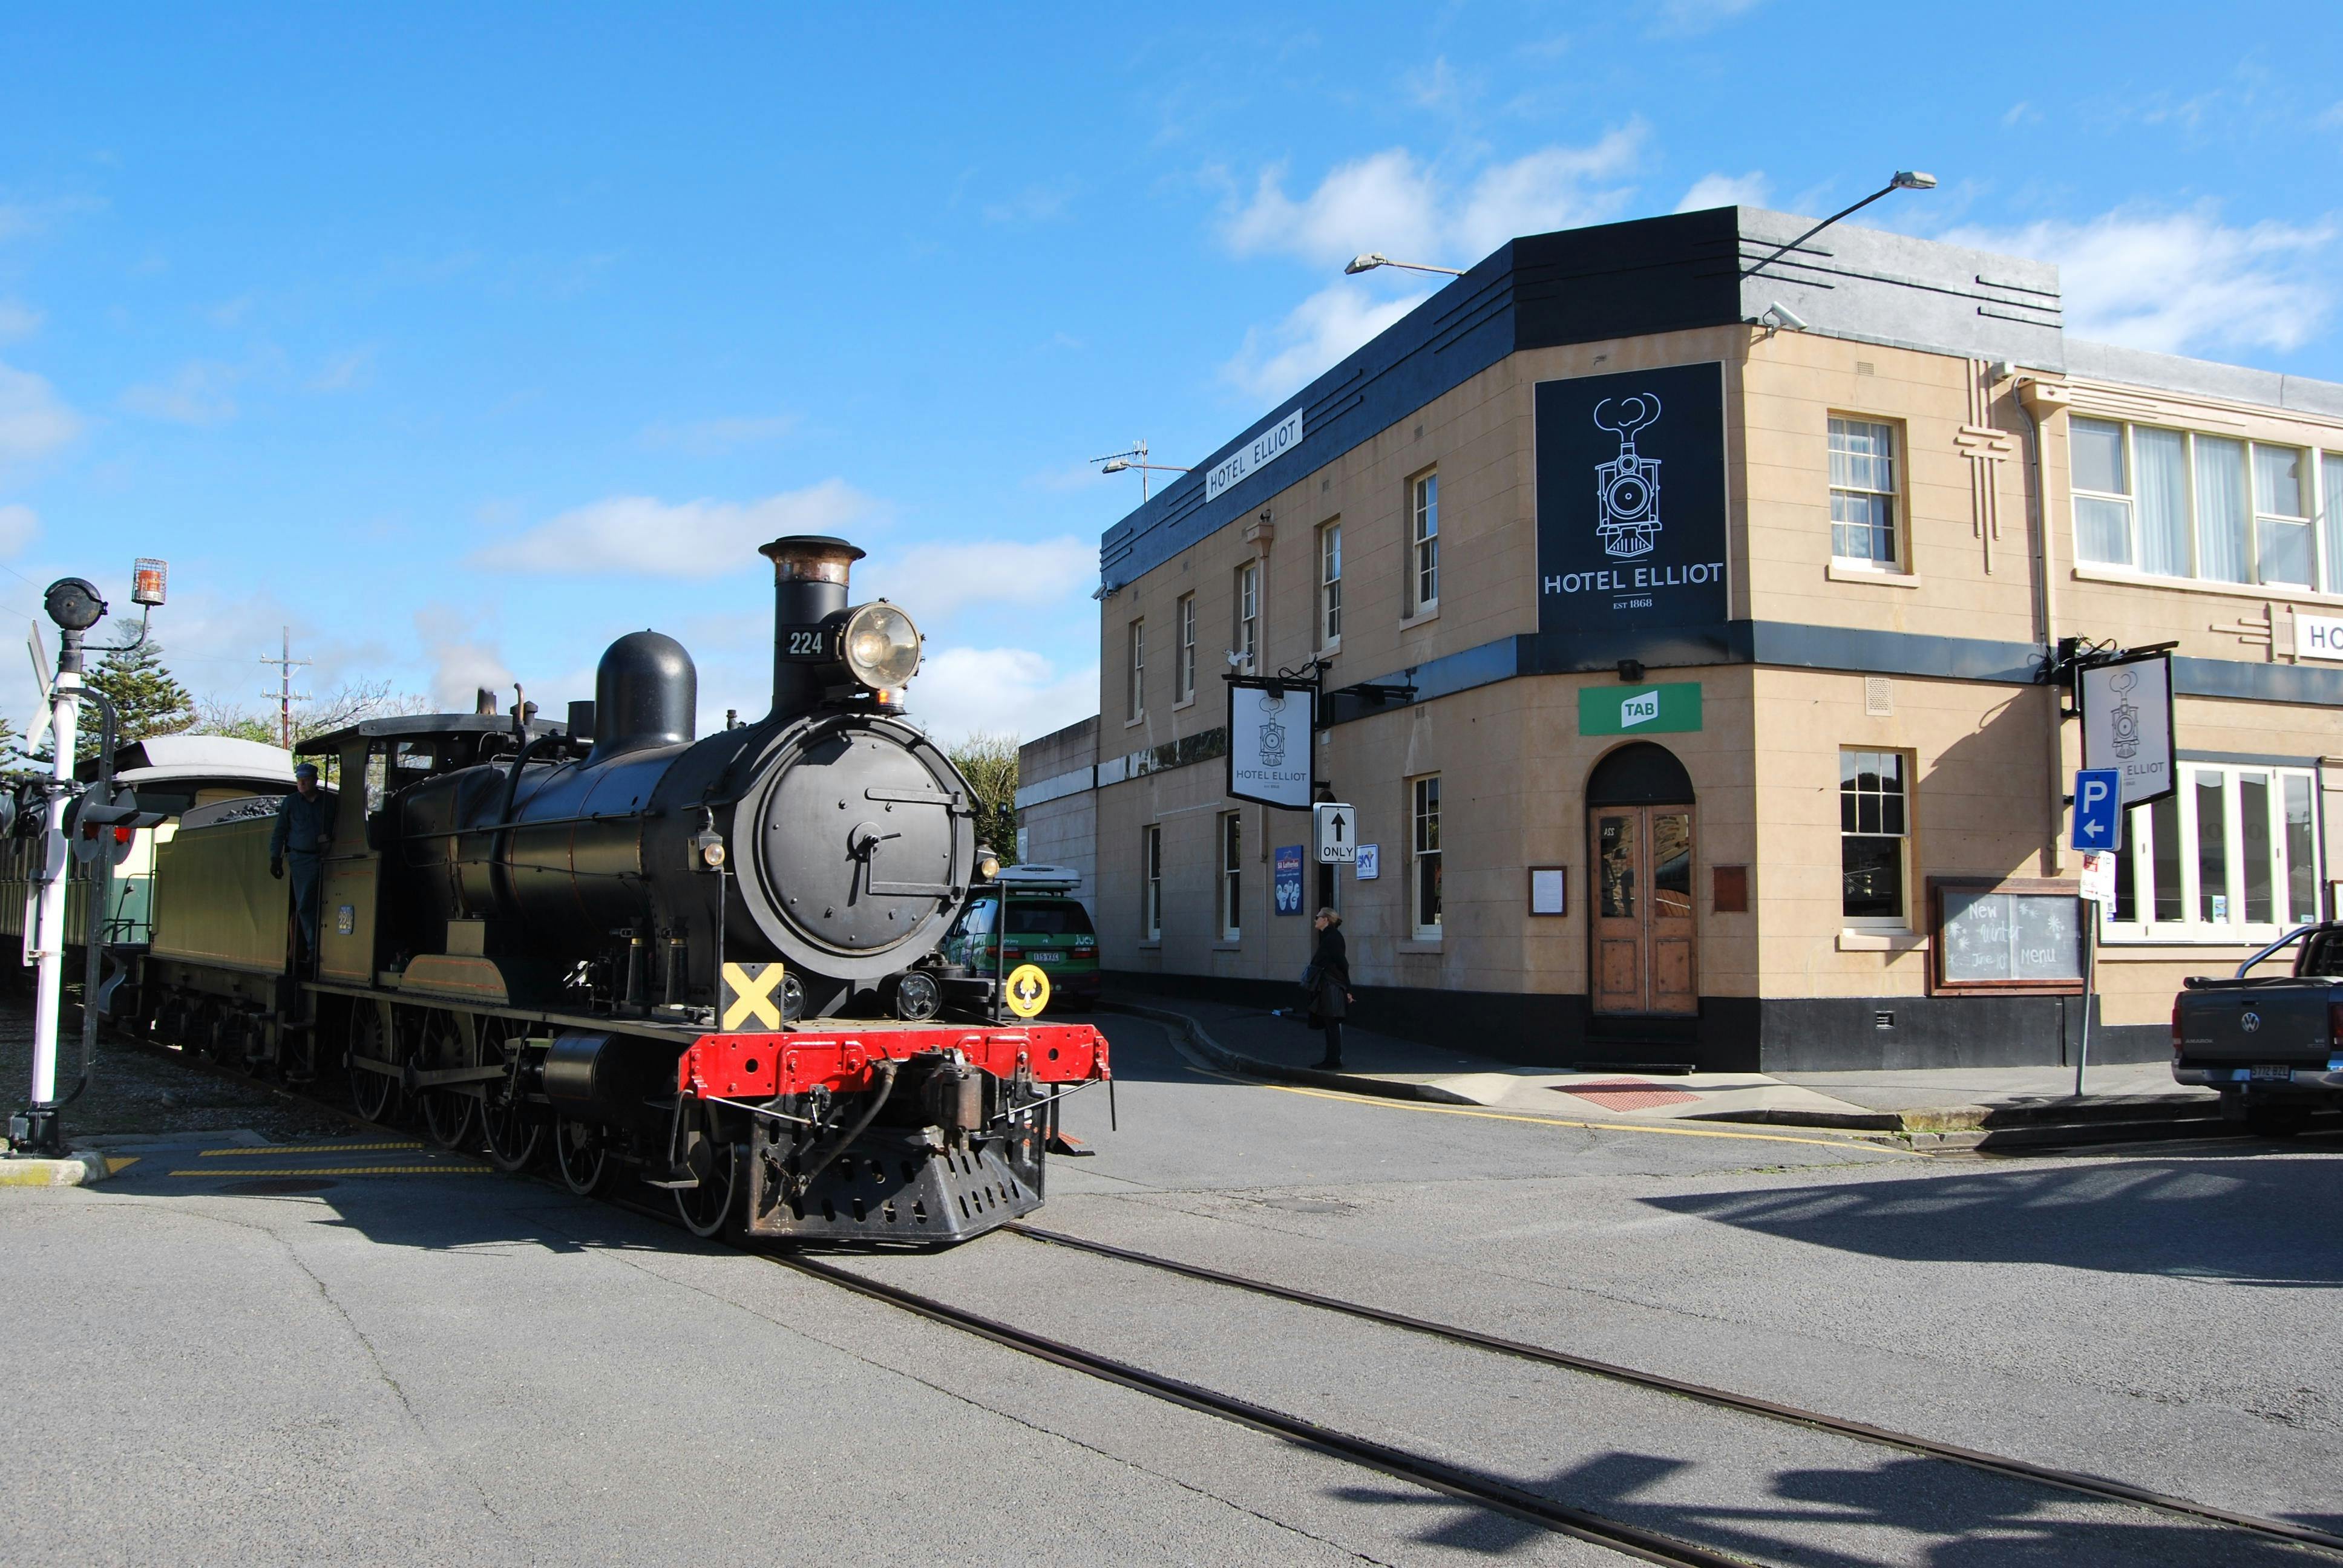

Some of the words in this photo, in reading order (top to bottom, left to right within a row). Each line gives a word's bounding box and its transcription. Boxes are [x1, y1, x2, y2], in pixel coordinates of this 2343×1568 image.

[1210, 457, 1245, 494] HOTEL
[1254, 420, 1296, 464] ELLIOT
[1544, 570, 1626, 594] HOTEL
[1635, 563, 1723, 587] ELLIOT
[1630, 598, 1653, 609] 1868
[789, 632, 823, 654] 224
[1625, 702, 1655, 716] TAB
[1236, 770, 1270, 780] HOTEL
[1273, 772, 1307, 782] ELLIOT
[2127, 762, 2164, 776] ELLIOT
[2083, 781, 2108, 814] P
[1323, 847, 1353, 857] ONLY
[1357, 853, 1374, 869] SKY
[1968, 903, 1997, 920] New
[2021, 948, 2057, 965] Menu
